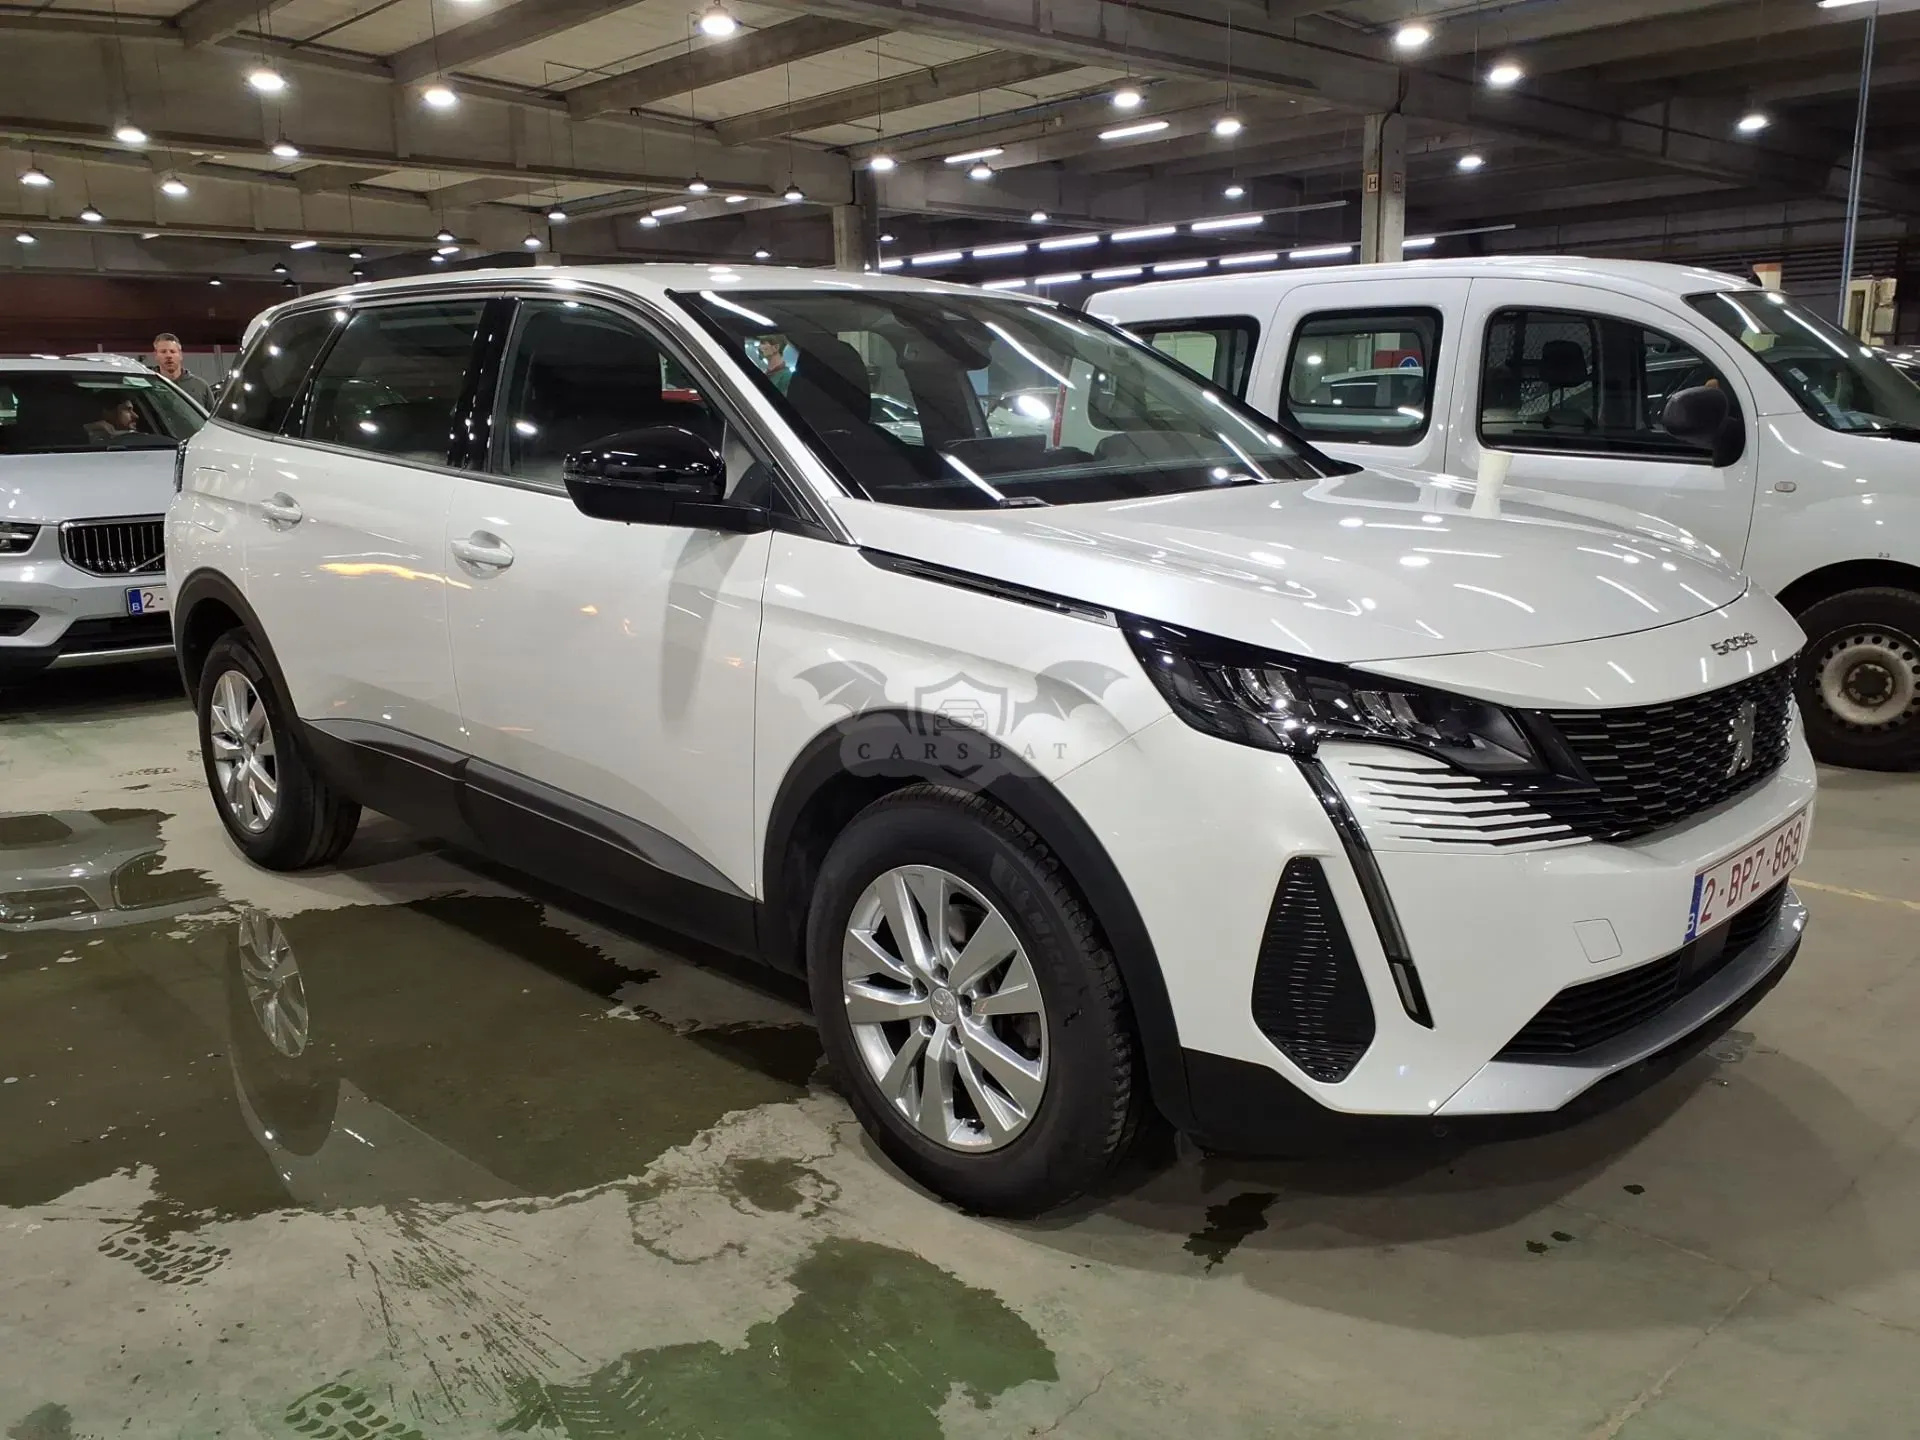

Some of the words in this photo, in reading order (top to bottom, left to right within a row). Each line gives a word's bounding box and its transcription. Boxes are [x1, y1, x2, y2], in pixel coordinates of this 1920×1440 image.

[1368, 175, 1377, 189] H
[132, 602, 141, 611] B
[1686, 912, 1696, 934] B
